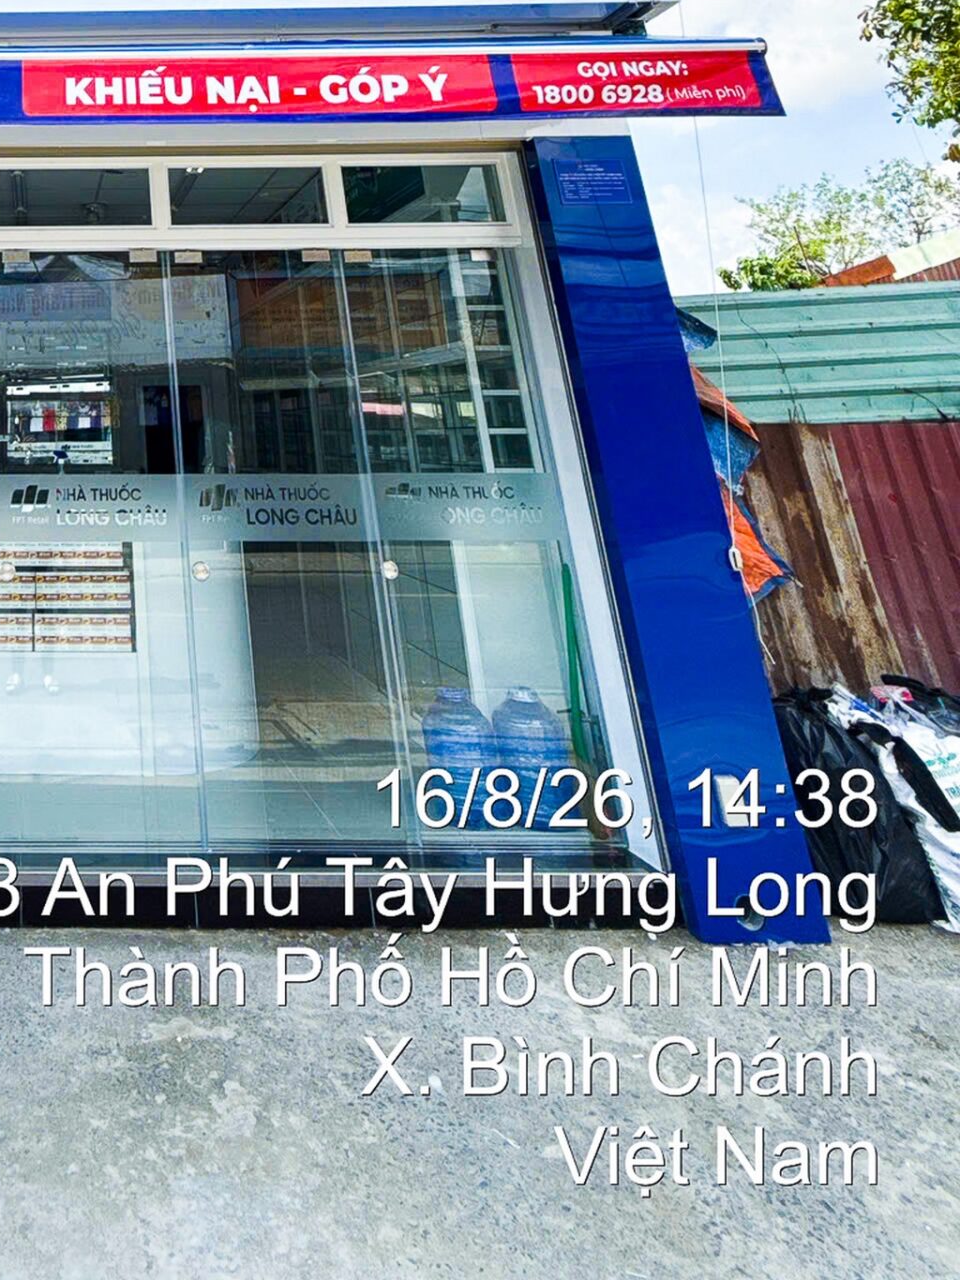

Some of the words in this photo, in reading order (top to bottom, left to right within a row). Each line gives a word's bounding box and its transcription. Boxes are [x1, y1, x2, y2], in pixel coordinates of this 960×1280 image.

[577, 61, 617, 81] GỌI
[623, 60, 689, 77] NGAY:
[65, 66, 193, 106] KHIẾU
[206, 73, 280, 115] NẠI
[320, 64, 407, 102] GÓP
[416, 63, 449, 100] Ý
[532, 85, 594, 104] 1800
[601, 84, 664, 104] 6928
[716, 85, 746, 102] phí)
[56, 484, 86, 501] NHÀ
[90, 483, 141, 501] THUỐC
[245, 484, 276, 501] NHÀ
[279, 482, 330, 501] THUỐC
[429, 483, 460, 499] NHÀ
[56, 509, 110, 525] LONG
[115, 505, 167, 526] CHÂU
[247, 508, 300, 525] LONG
[305, 504, 357, 525] CHÂU
